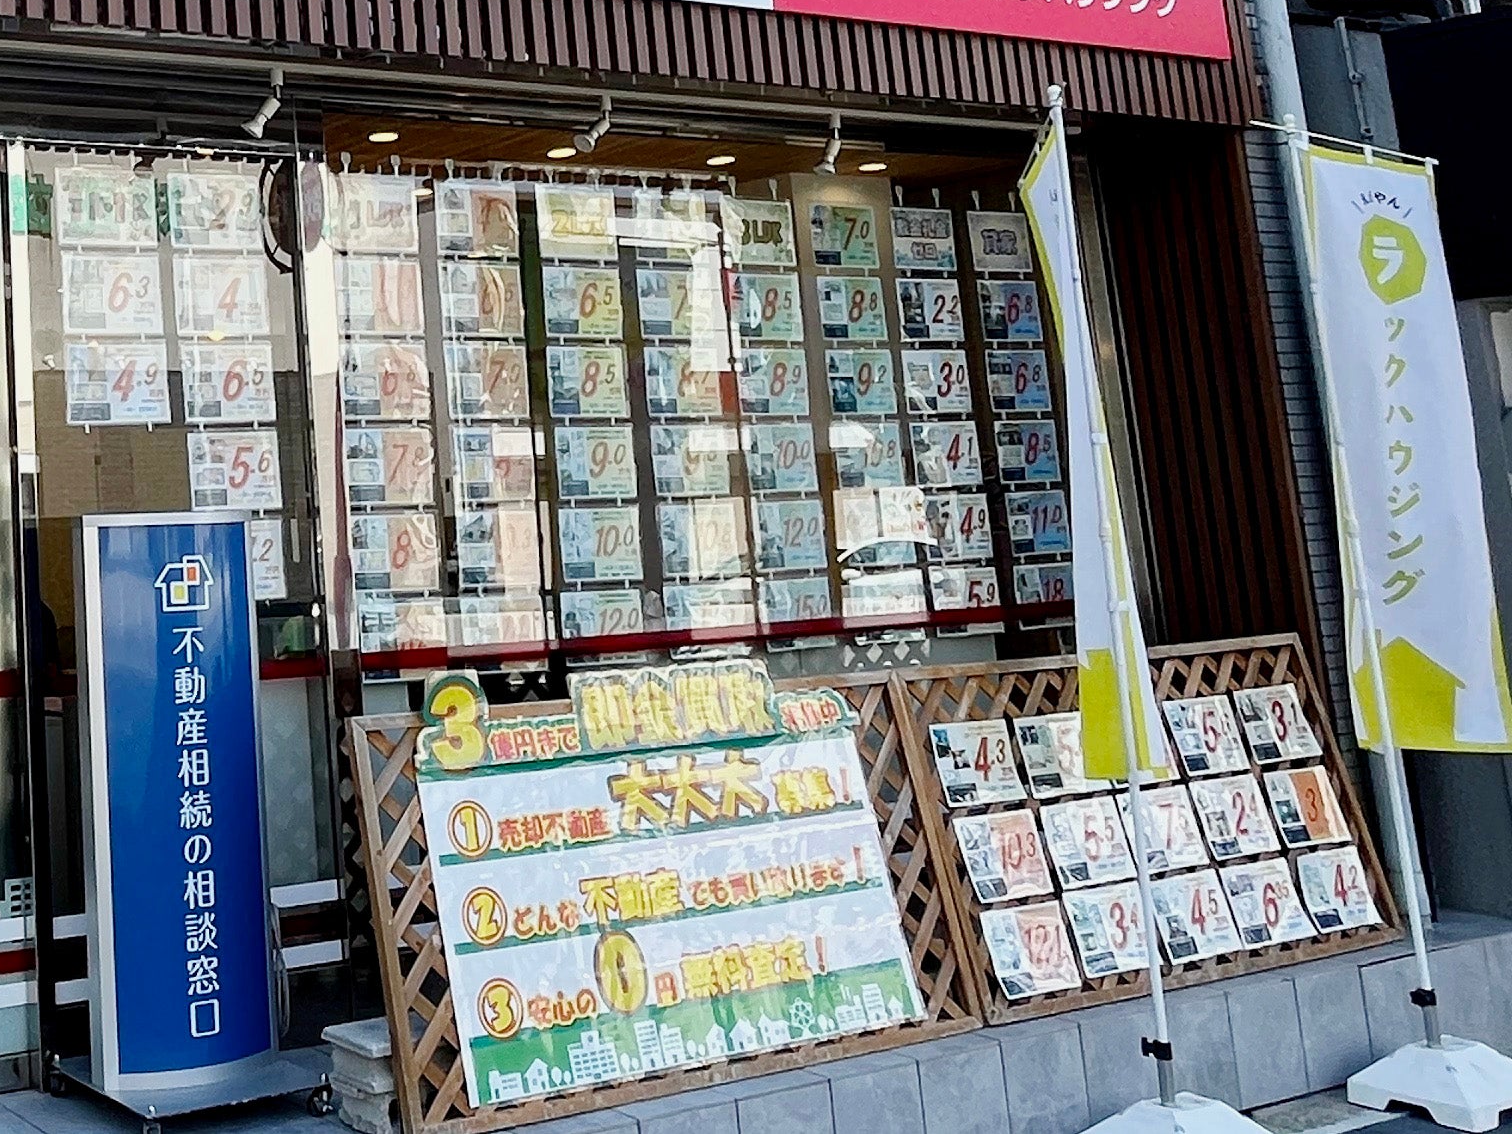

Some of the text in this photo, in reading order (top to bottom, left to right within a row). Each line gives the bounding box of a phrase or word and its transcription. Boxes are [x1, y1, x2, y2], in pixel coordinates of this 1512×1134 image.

[579, 282, 613, 318] 6.5
[581, 360, 616, 397] 8.5
[938, 360, 965, 398] 3.0
[228, 445, 272, 489] 5.6
[589, 440, 627, 479] 9.0
[596, 523, 634, 558] 10.0
[974, 736, 1006, 782] 4.3
[172, 626, 221, 1039] 不動産相続の相談窓口
[1334, 863, 1358, 907] 4.2
[1191, 888, 1219, 936] 4.5
